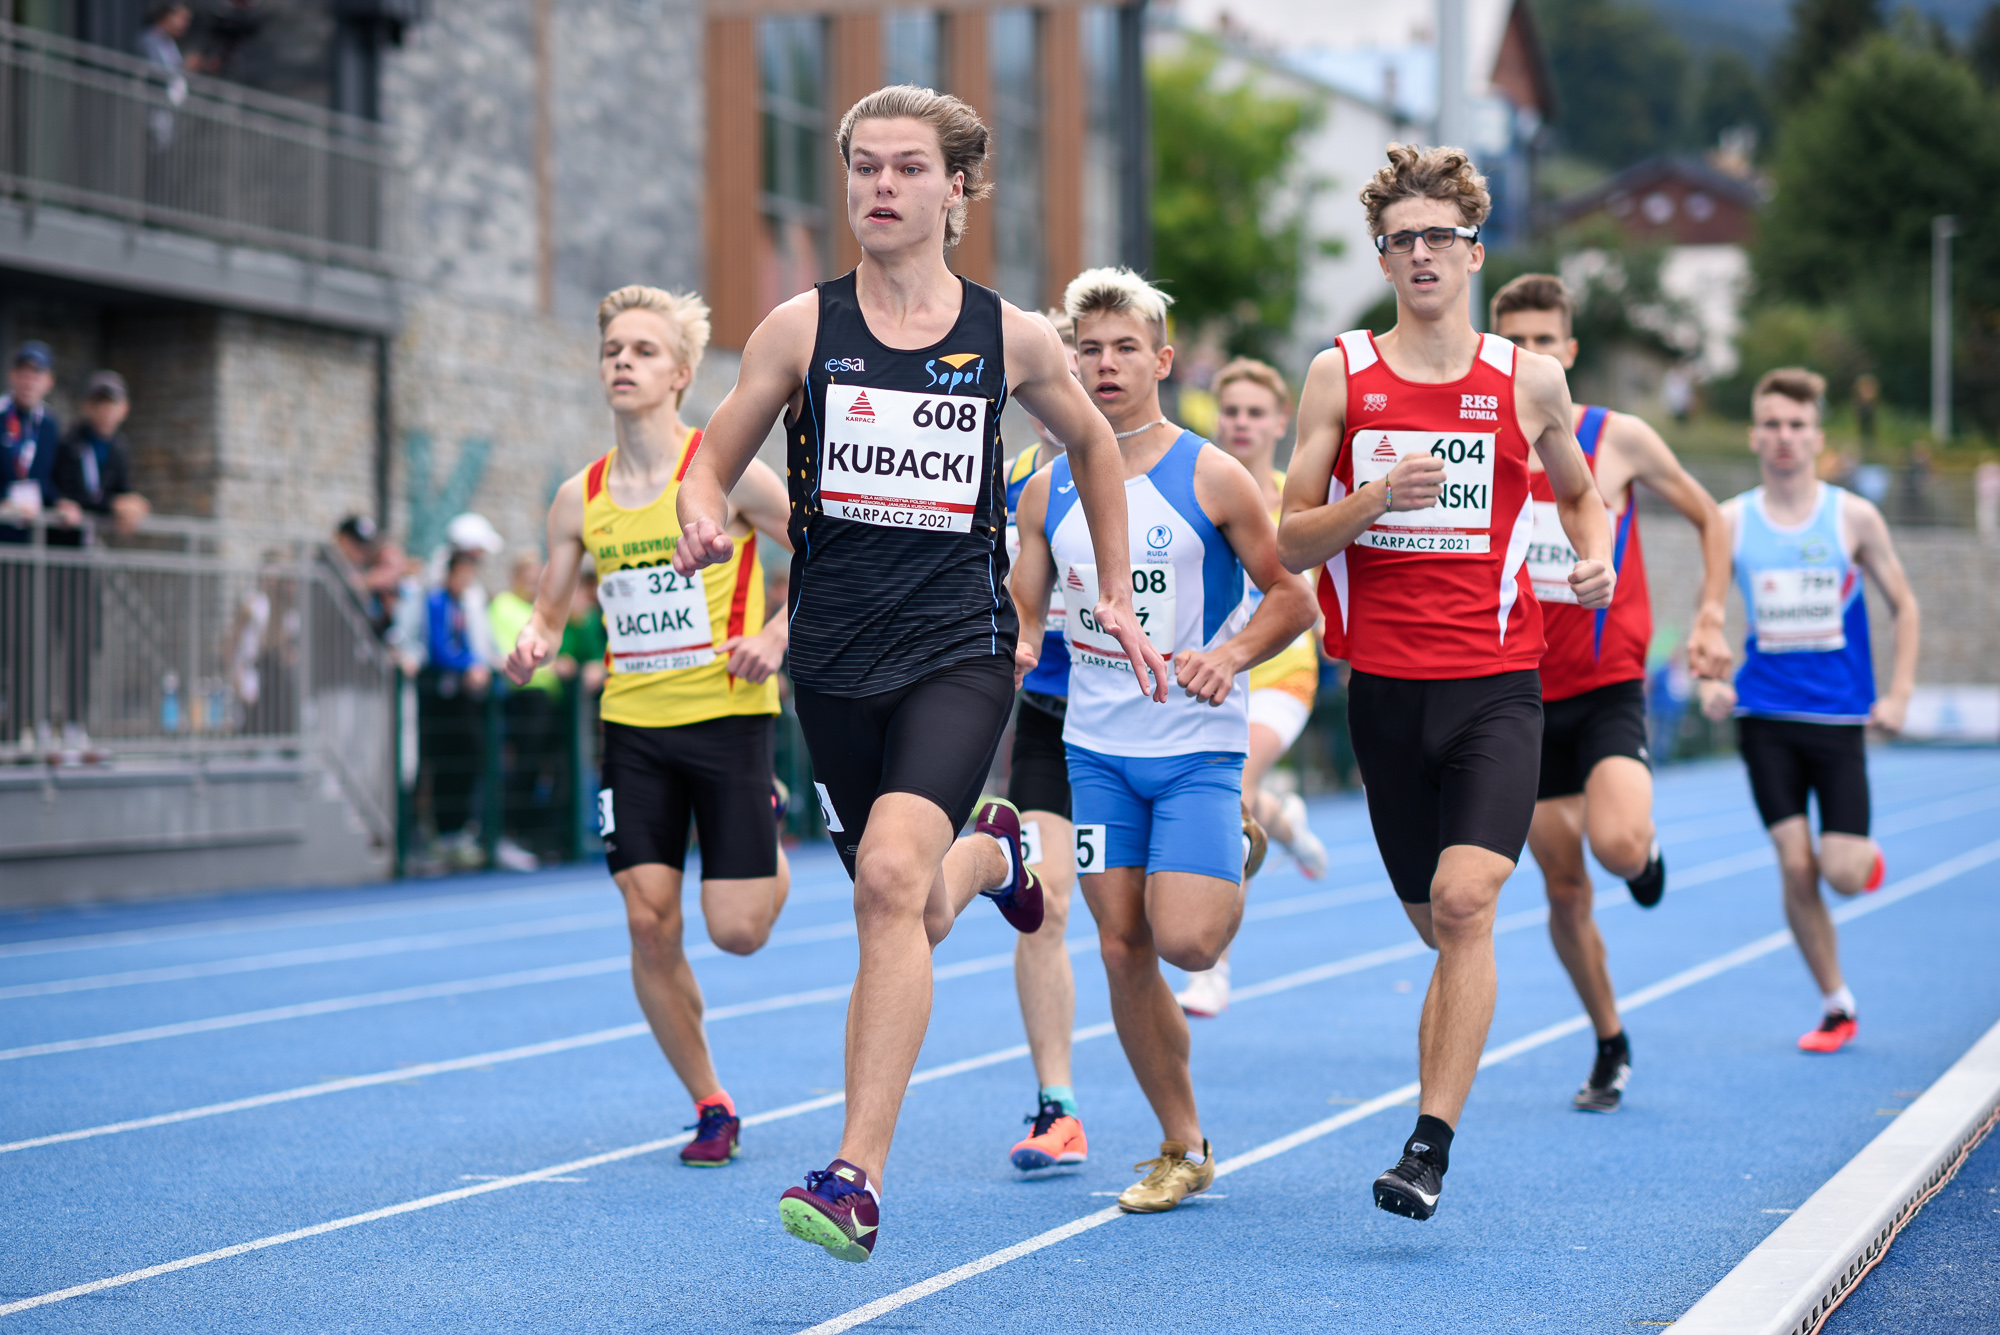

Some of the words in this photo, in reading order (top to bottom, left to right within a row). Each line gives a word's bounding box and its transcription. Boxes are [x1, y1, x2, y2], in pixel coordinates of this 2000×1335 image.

[925, 358, 985, 394] Sopot
[1460, 394, 1499, 410] RKS
[845, 416, 876, 424] KARPACZ
[912, 399, 977, 432] 608
[1459, 409, 1499, 421] RUMIA
[827, 441, 975, 484] KUBACKI
[1431, 439, 1485, 465] 604
[842, 505, 914, 525] KARPACZ
[918, 513, 952, 529] 2021
[1371, 534, 1435, 549] KARPACZ
[1439, 538, 1470, 550] 2021
[1525, 542, 1579, 565] ZERN
[1132, 569, 1167, 594] 08
[616, 607, 694, 636] ŁACIAK
[1080, 652, 1132, 671] KARPACZ
[1077, 828, 1095, 868] 5
